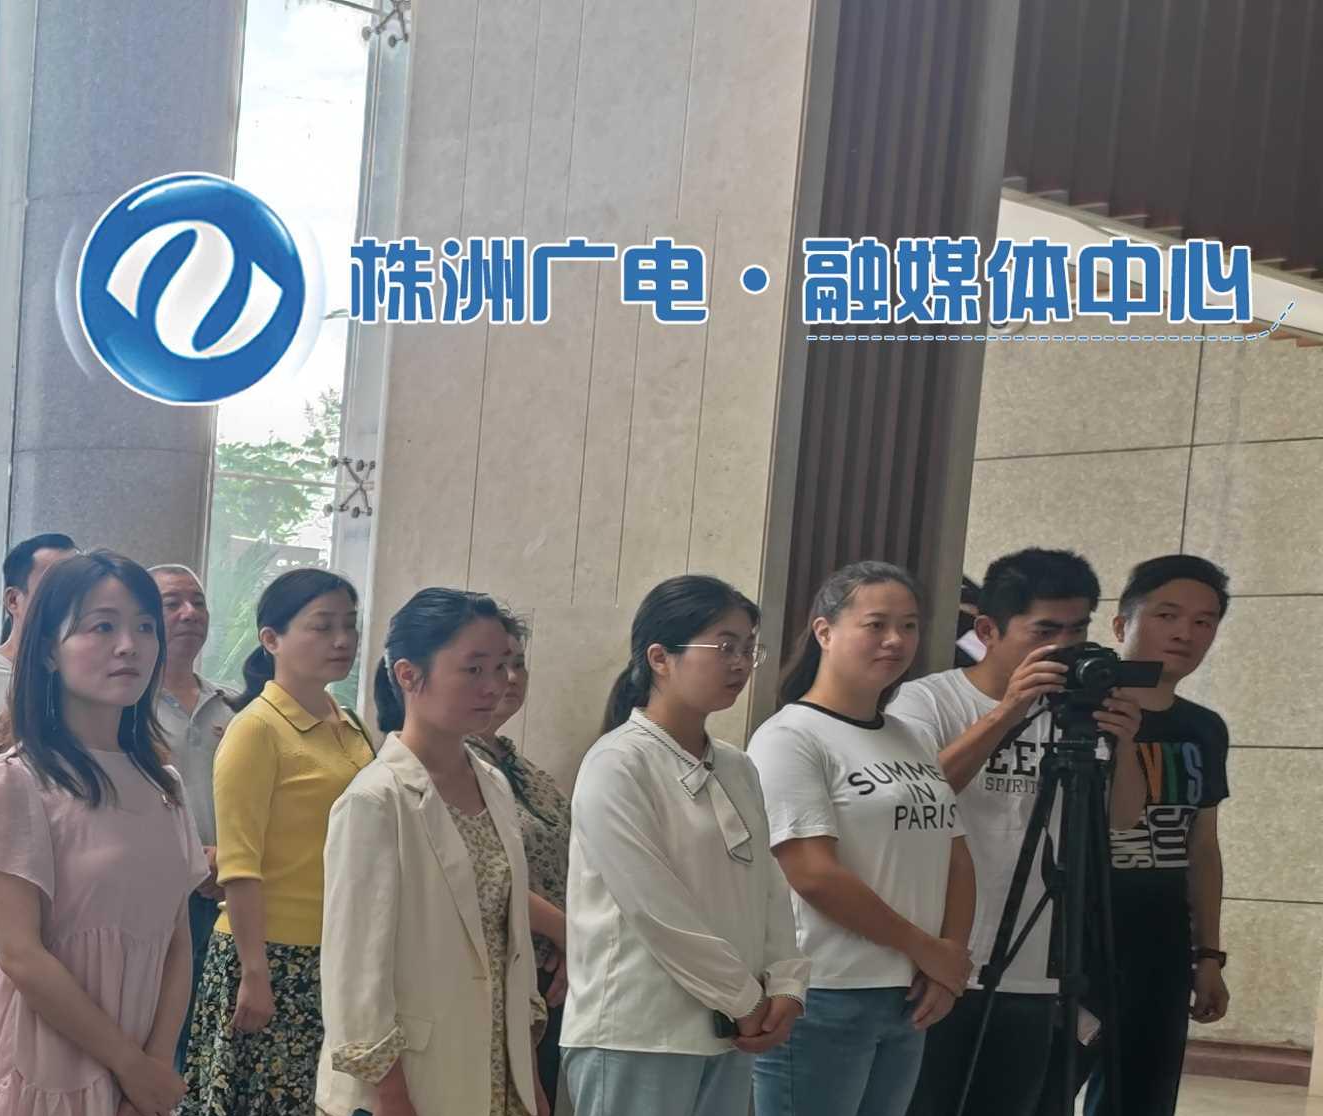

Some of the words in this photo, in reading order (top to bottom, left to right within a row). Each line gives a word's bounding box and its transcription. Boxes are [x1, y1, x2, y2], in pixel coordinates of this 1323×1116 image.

[847, 760, 948, 796] SUMME
[906, 782, 937, 804] IN
[1110, 827, 1154, 869] ANS
